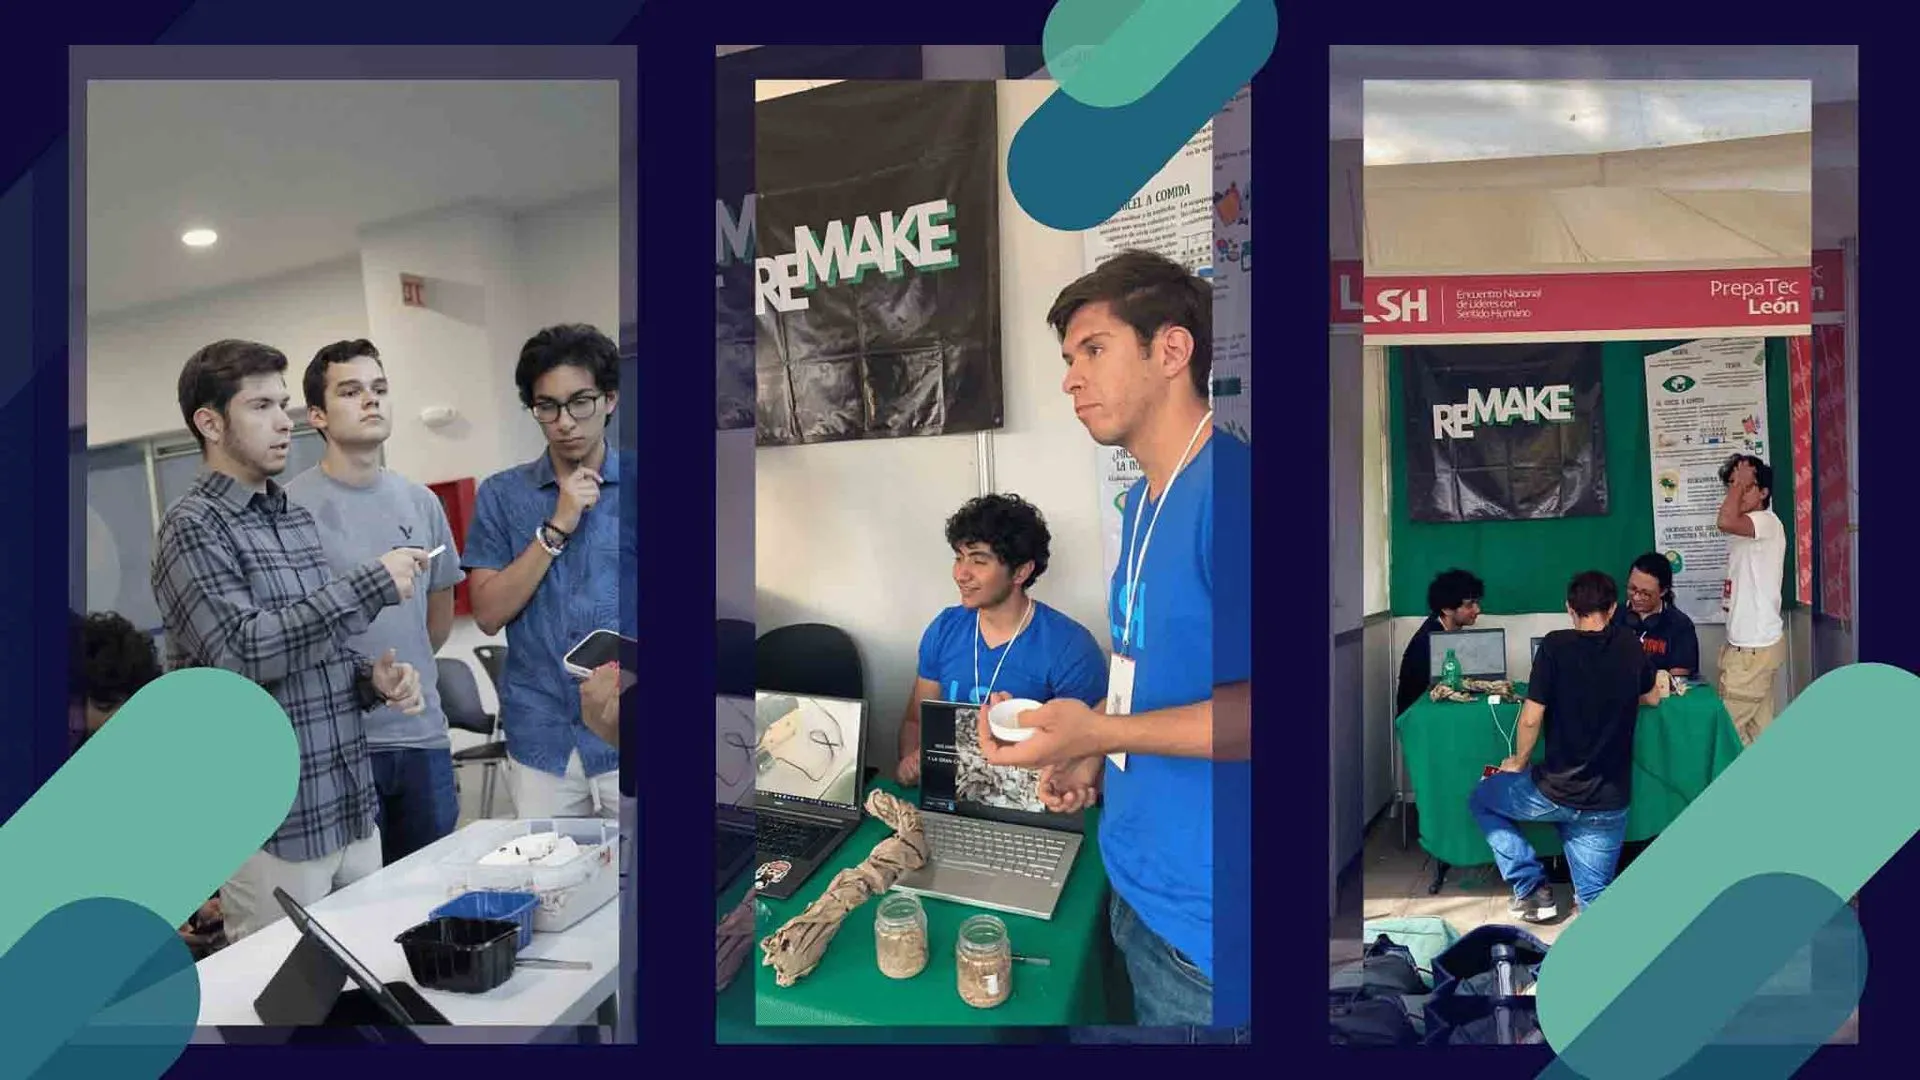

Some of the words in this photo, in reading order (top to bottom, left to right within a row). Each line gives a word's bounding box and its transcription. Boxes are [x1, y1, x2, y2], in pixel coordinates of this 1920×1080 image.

[1146, 195, 1152, 206] A
[1155, 183, 1190, 202] COMIDA
[1711, 278, 1799, 300] PrepaTec
[1364, 288, 1427, 323] SH
[1456, 289, 1502, 299] Encuentro
[1504, 287, 1541, 298] Nacional
[1456, 300, 1467, 308] de
[1500, 300, 1517, 308] con
[1456, 308, 1490, 318] Sentido
[1491, 308, 1531, 317] Humano
[1749, 296, 1799, 314] León
[1433, 384, 1574, 439] REMAKE
